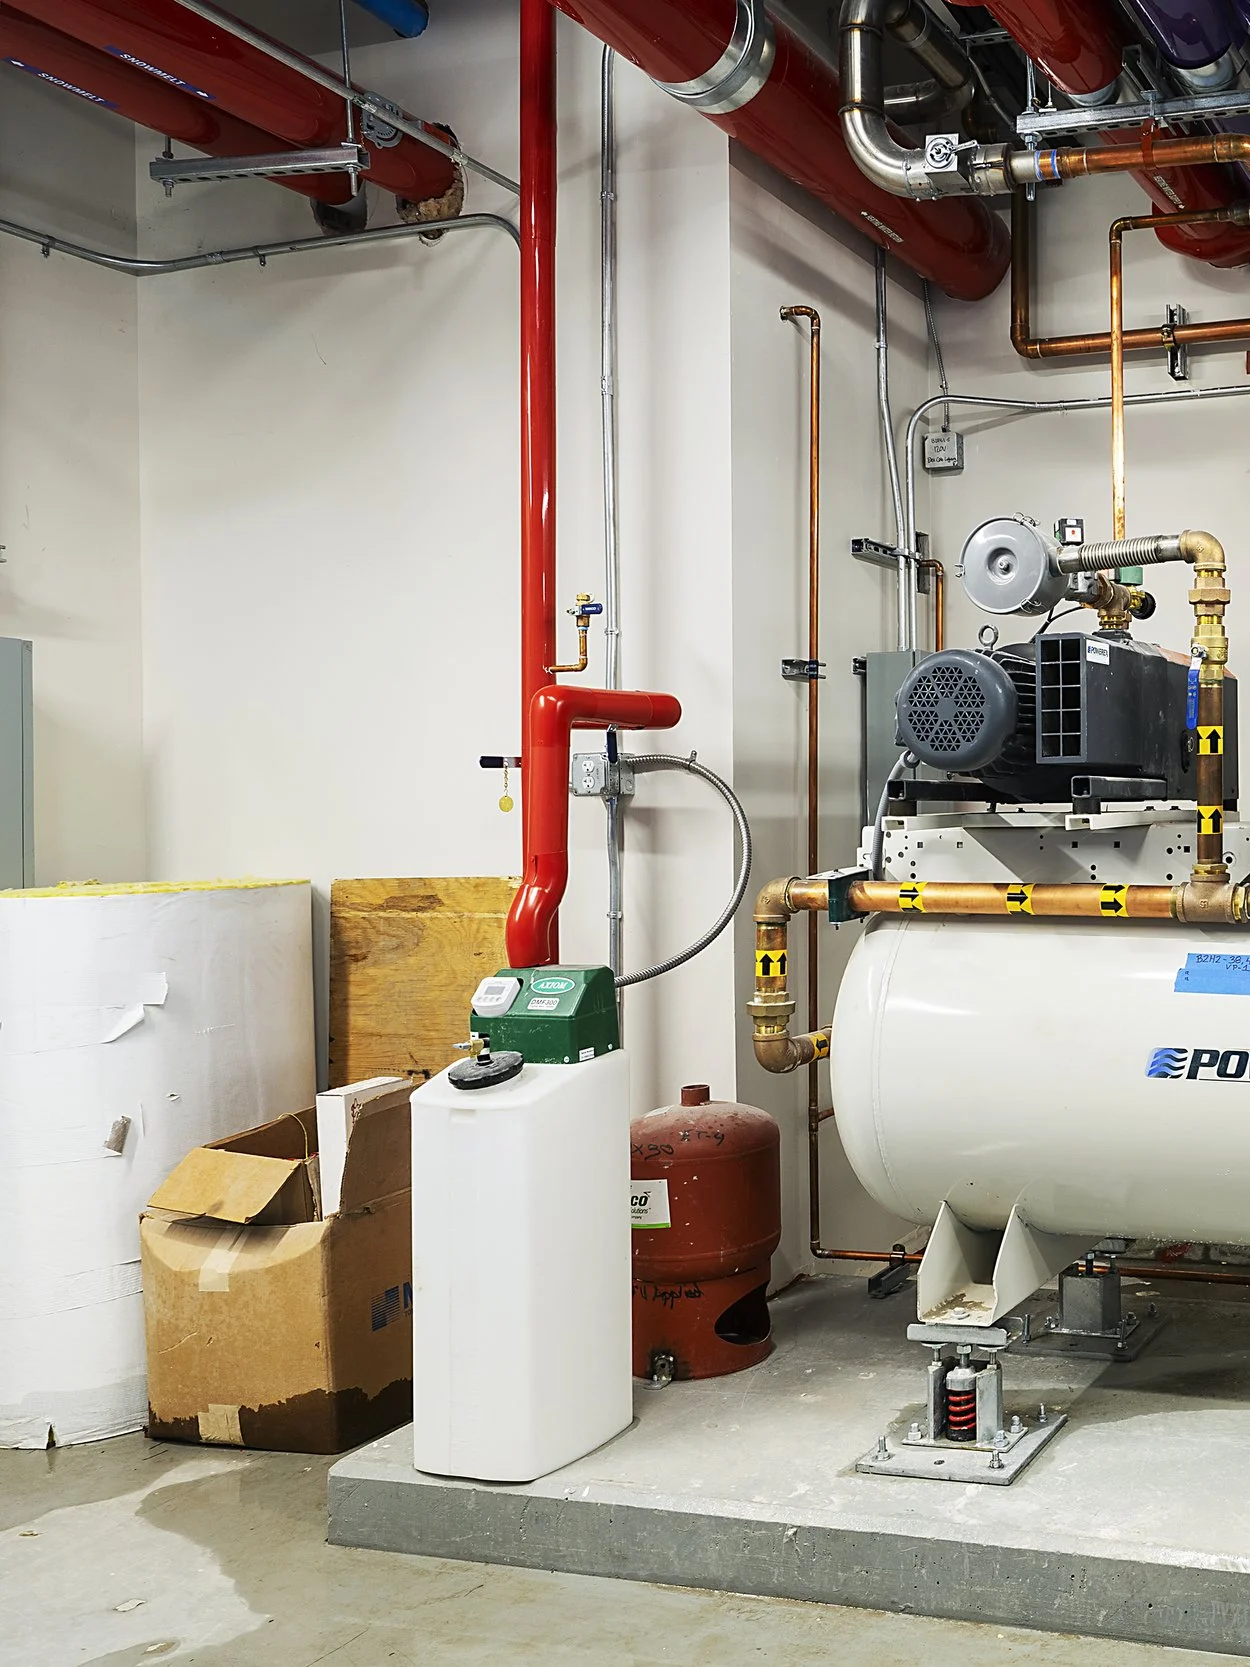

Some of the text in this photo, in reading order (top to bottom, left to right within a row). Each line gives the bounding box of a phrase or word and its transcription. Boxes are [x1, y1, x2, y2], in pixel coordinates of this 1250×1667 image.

[120, 54, 185, 85] SNOWMELT
[38, 72, 104, 102] SNOWMELT
[537, 981, 568, 989] AXIOM
